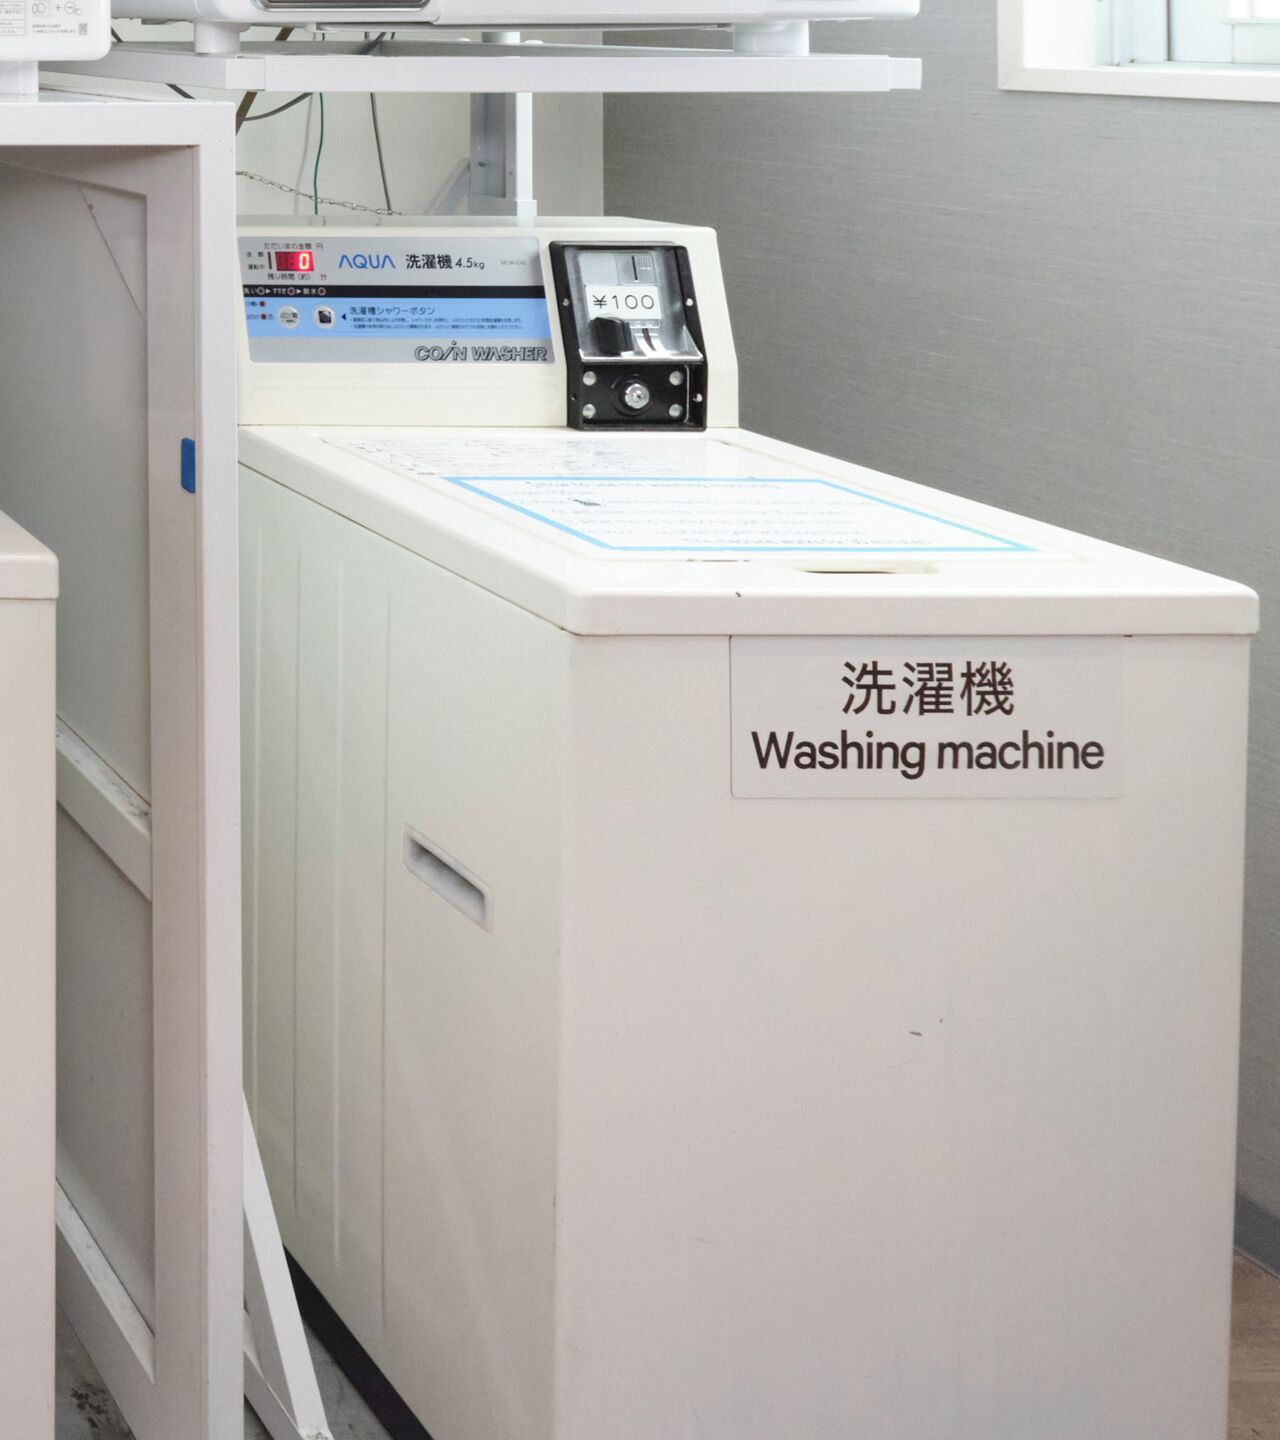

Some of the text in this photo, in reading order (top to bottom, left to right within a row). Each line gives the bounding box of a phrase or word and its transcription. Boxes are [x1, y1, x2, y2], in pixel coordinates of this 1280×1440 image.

[298, 252, 310, 270] 0
[405, 254, 453, 270] 洗濯機
[455, 257, 485, 271] 4.5kg
[592, 294, 655, 310] ¥100
[414, 340, 547, 361] COIN WASHER
[841, 660, 1015, 716] 洗濯機
[751, 729, 1105, 780] Washing machine
